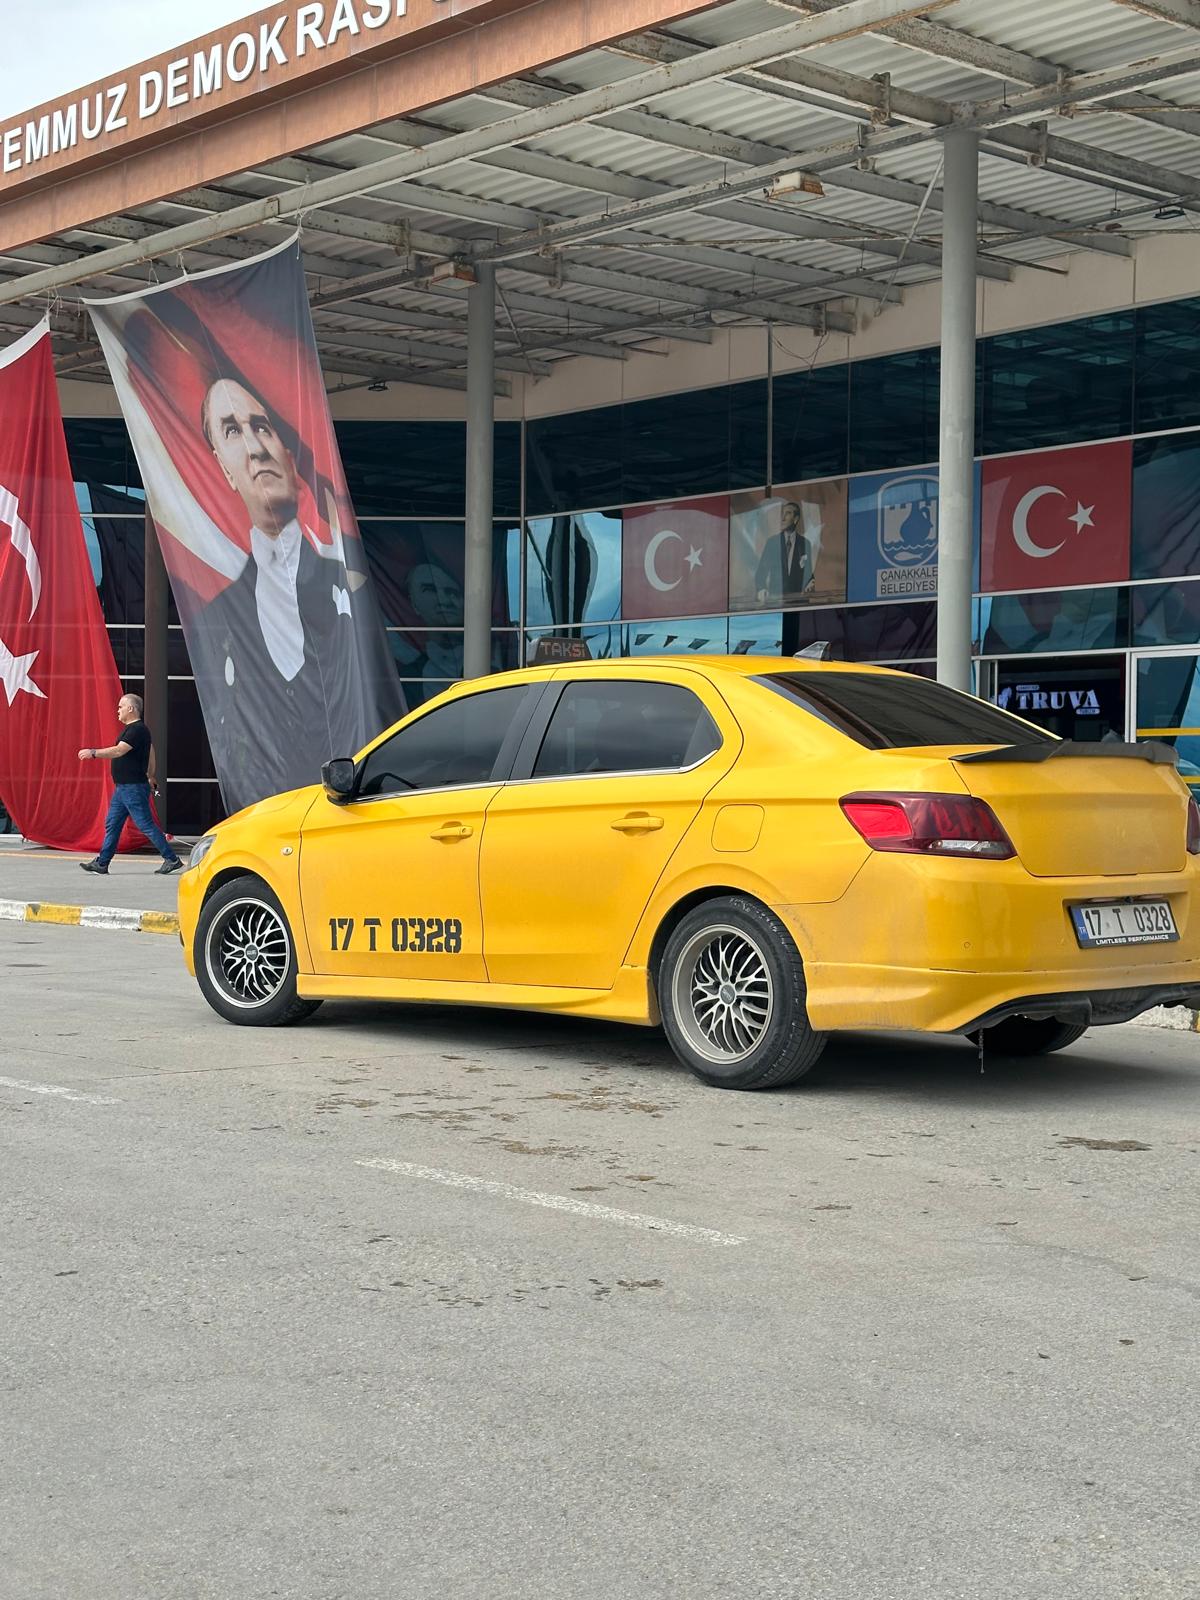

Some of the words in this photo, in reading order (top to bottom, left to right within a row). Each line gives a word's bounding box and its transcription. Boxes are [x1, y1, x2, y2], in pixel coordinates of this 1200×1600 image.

[0, 83, 128, 173] EMMUZ
[880, 567, 938, 582] ÇANAKKALE
[1015, 689, 1100, 709] TRUVA
[1085, 909, 1102, 936] 17
[1112, 909, 1125, 933] T
[1133, 905, 1171, 933] 0328
[329, 918, 354, 951] 17
[363, 918, 382, 951] T
[391, 918, 462, 953] 0328
[1128, 934, 1169, 942] PERFORMANCE
